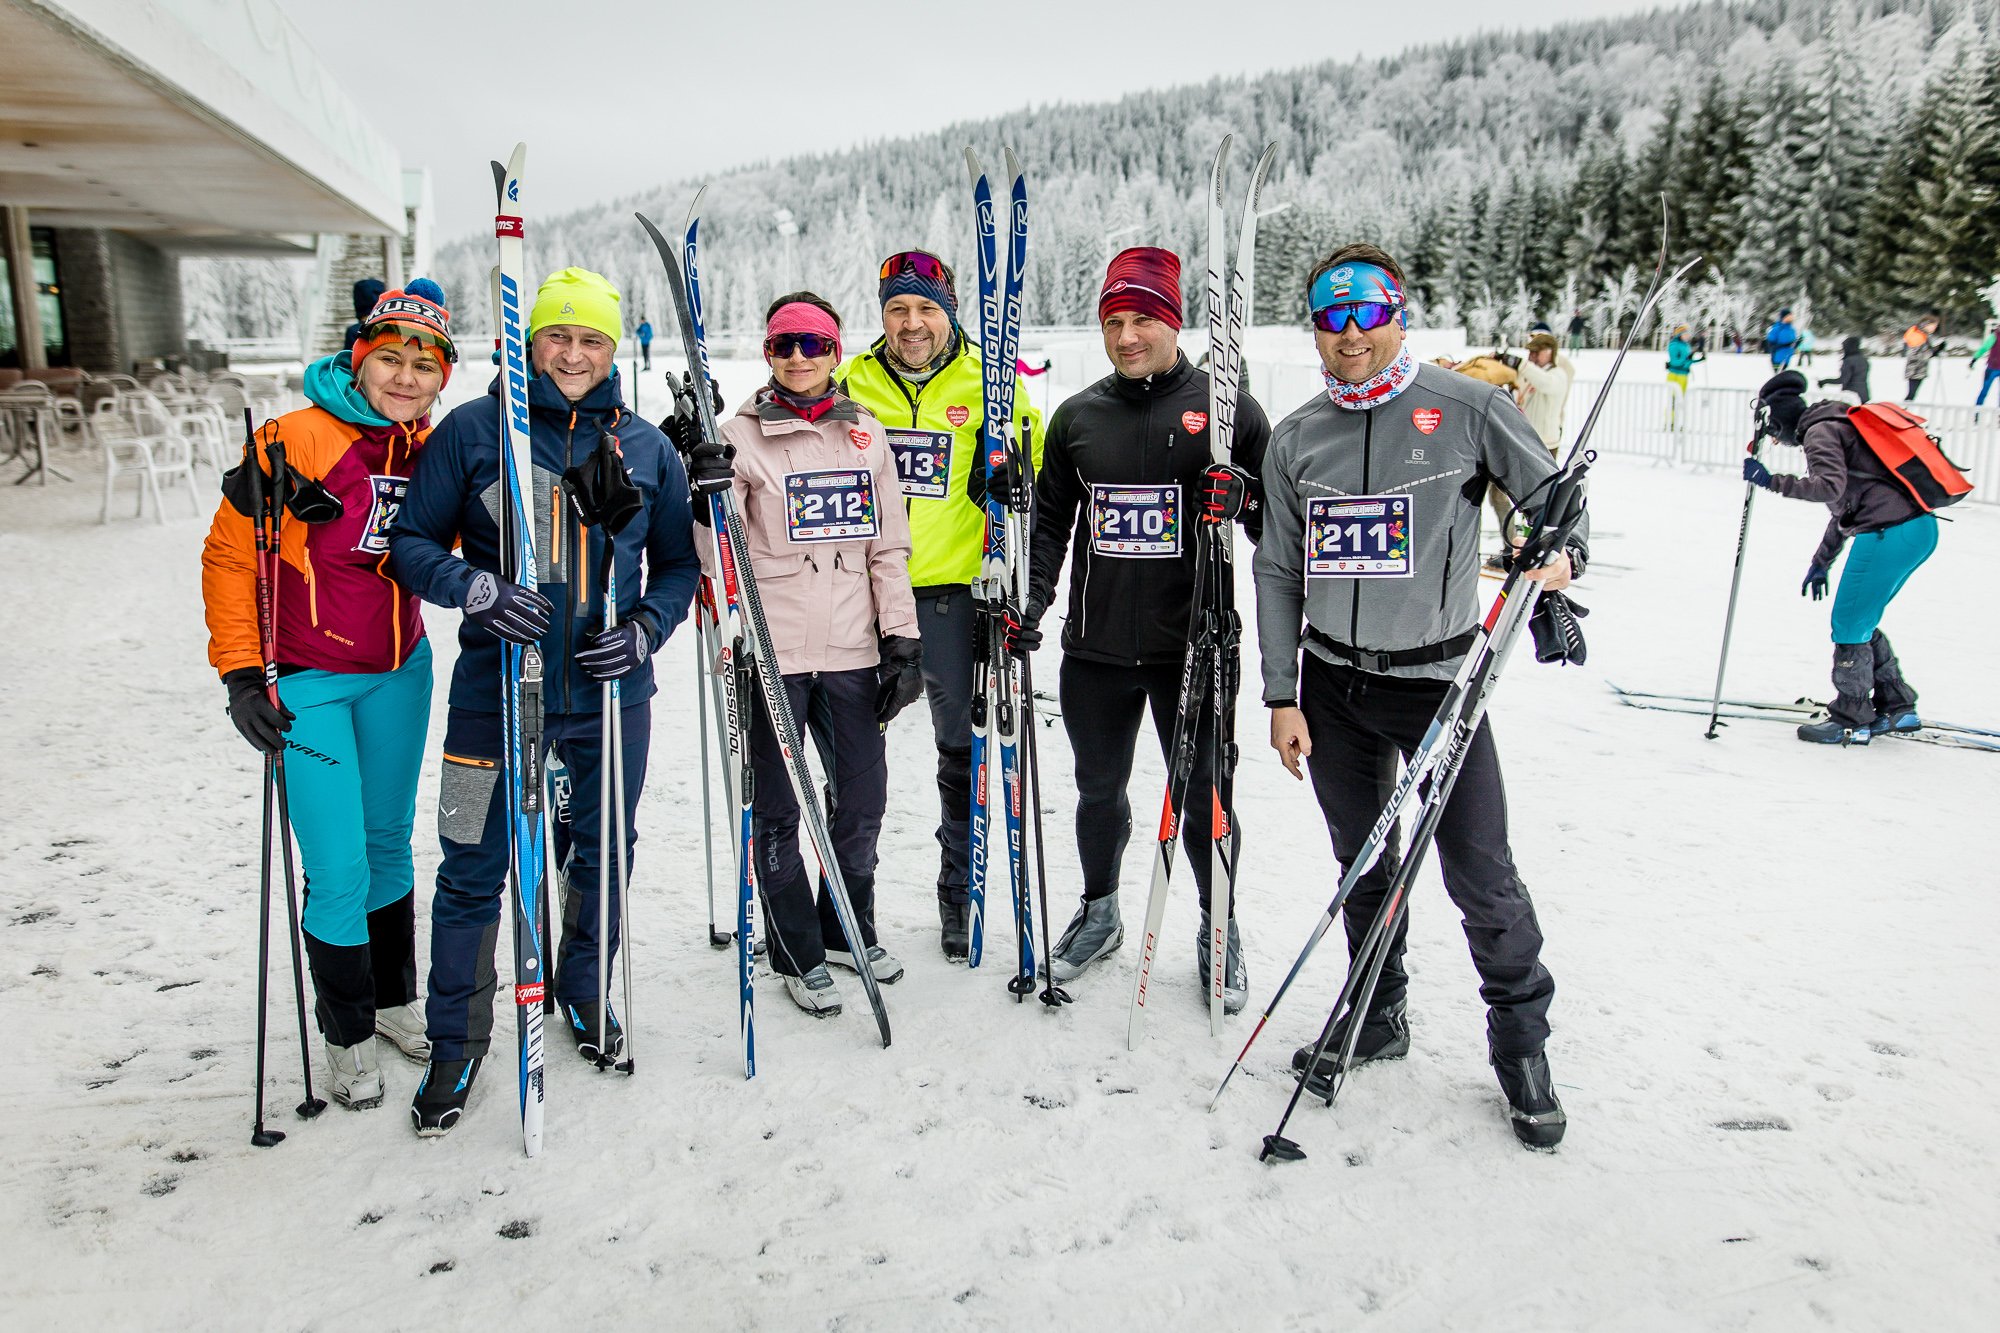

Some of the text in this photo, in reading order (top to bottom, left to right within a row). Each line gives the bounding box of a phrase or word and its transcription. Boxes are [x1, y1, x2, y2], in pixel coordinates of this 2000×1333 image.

[501, 272, 530, 437] KARHU
[983, 289, 1003, 441] ROSSIGNOL
[1000, 290, 1023, 422] OSSIGNOL
[1208, 269, 1232, 451] PELTONEN
[898, 451, 934, 477] 13
[804, 492, 862, 520] 212
[1104, 508, 1164, 535] 210
[1322, 523, 1387, 552] 211
[260, 577, 272, 644] salomon
[723, 661, 740, 757] ROSSIGNOL
[1179, 641, 1195, 716] PELTONEN
[1213, 643, 1221, 716] PELTONEN
[284, 738, 341, 766] NAFIT
[1368, 746, 1428, 846] PELTONEN
[973, 815, 985, 897] XTOUR
[745, 899, 754, 990] XTOUR
[1137, 932, 1154, 1007] DELTA
